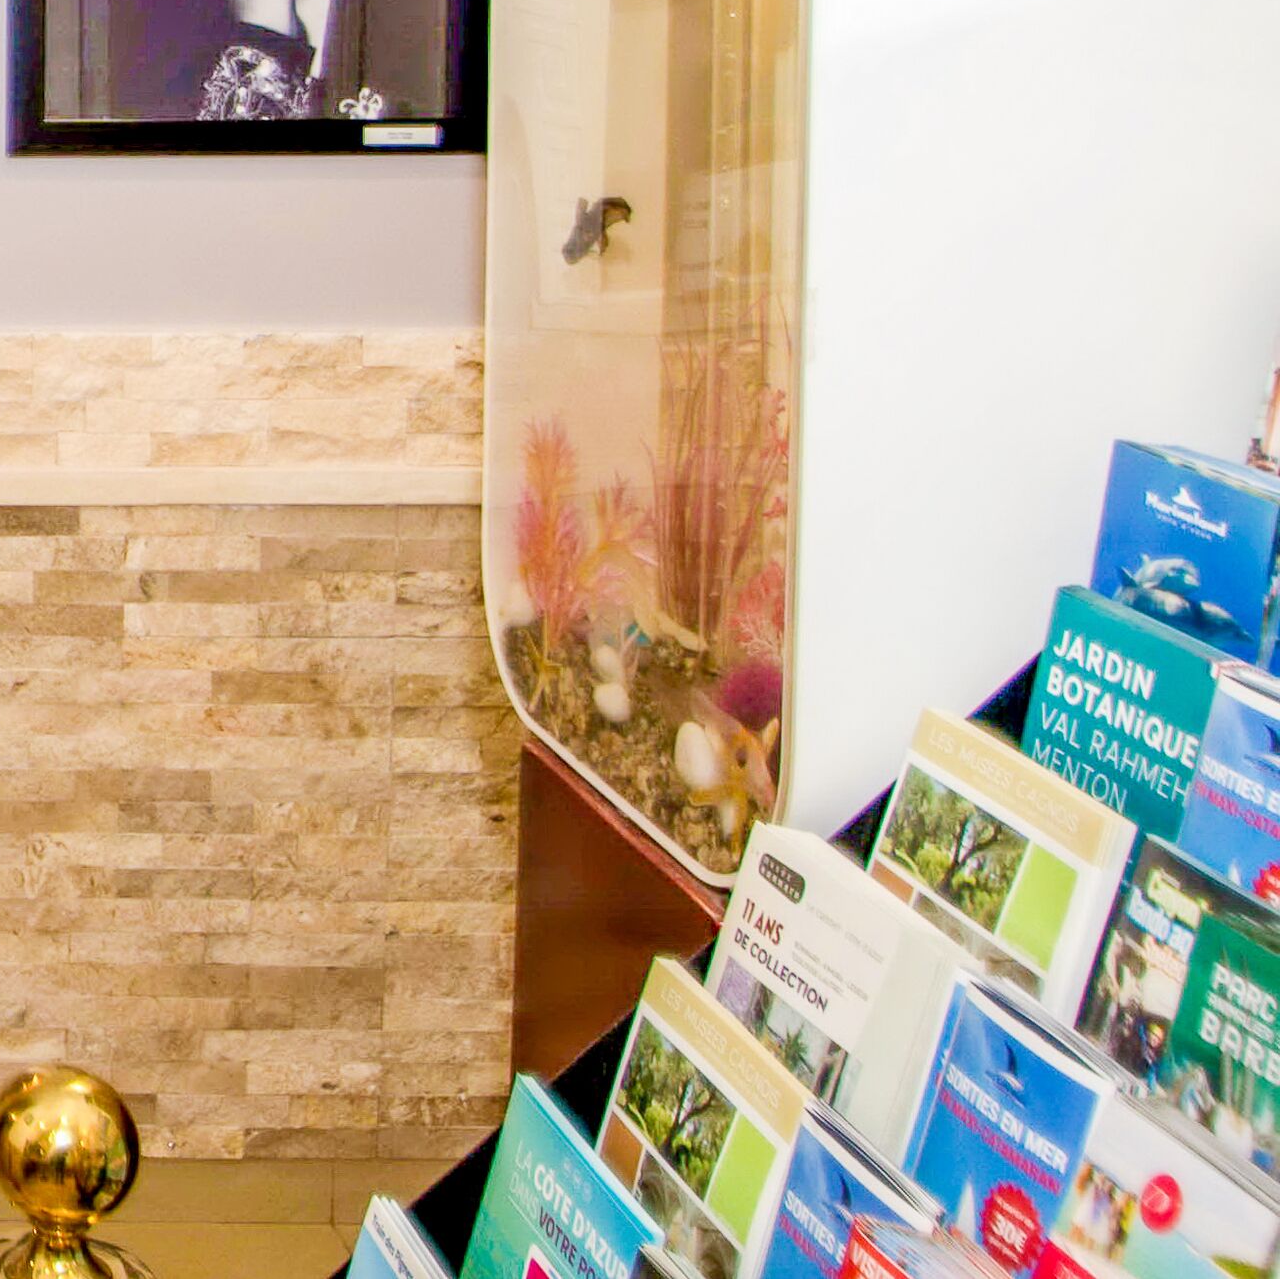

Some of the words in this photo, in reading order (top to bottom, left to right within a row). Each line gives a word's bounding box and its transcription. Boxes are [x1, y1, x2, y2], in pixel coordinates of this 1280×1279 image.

[1031, 738, 1128, 813] MENTON
[1041, 702, 1081, 749] VAL
[1089, 728, 1190, 803] RAHMEH
[1200, 753, 1266, 805] SORTIES
[742, 898, 756, 920] 11
[753, 912, 784, 945] ANS
[734, 928, 750, 950] DE
[749, 942, 829, 1013] COLLECTION
[1211, 962, 1278, 1023] PARC
[945, 1062, 1001, 1123] SORTIES
[999, 1108, 1025, 1144] EN
[1023, 1125, 1069, 1176] MER
[509, 1171, 539, 1220] DANS
[539, 1206, 578, 1268] VOTRE
[515, 1140, 533, 1178] LA
[534, 1163, 573, 1225] CÔTE
[784, 1189, 837, 1256] SORTIES
